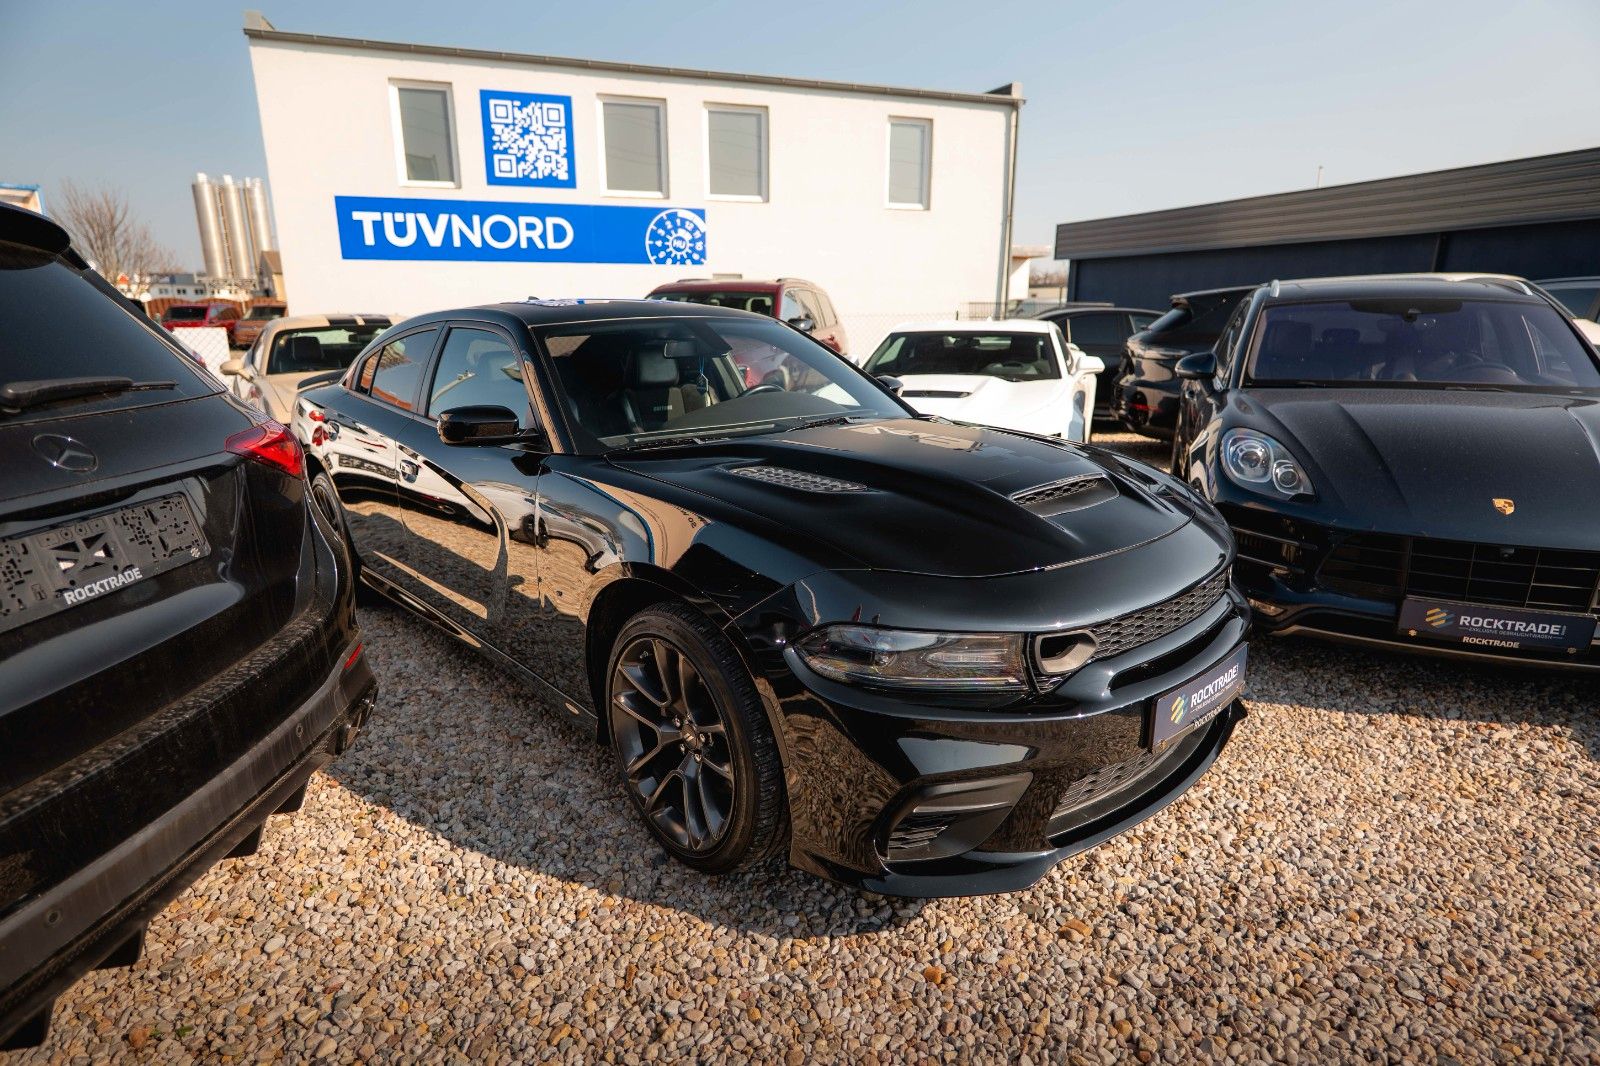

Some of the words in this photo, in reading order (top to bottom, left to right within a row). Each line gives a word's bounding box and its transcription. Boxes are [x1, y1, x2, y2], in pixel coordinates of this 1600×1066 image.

[64, 567, 143, 605] ROCKTRADE
[1459, 615, 1561, 636] ROCKTRADE
[1462, 636, 1521, 649] ROCKTRADE
[1190, 666, 1238, 708] ROCKTRADE
